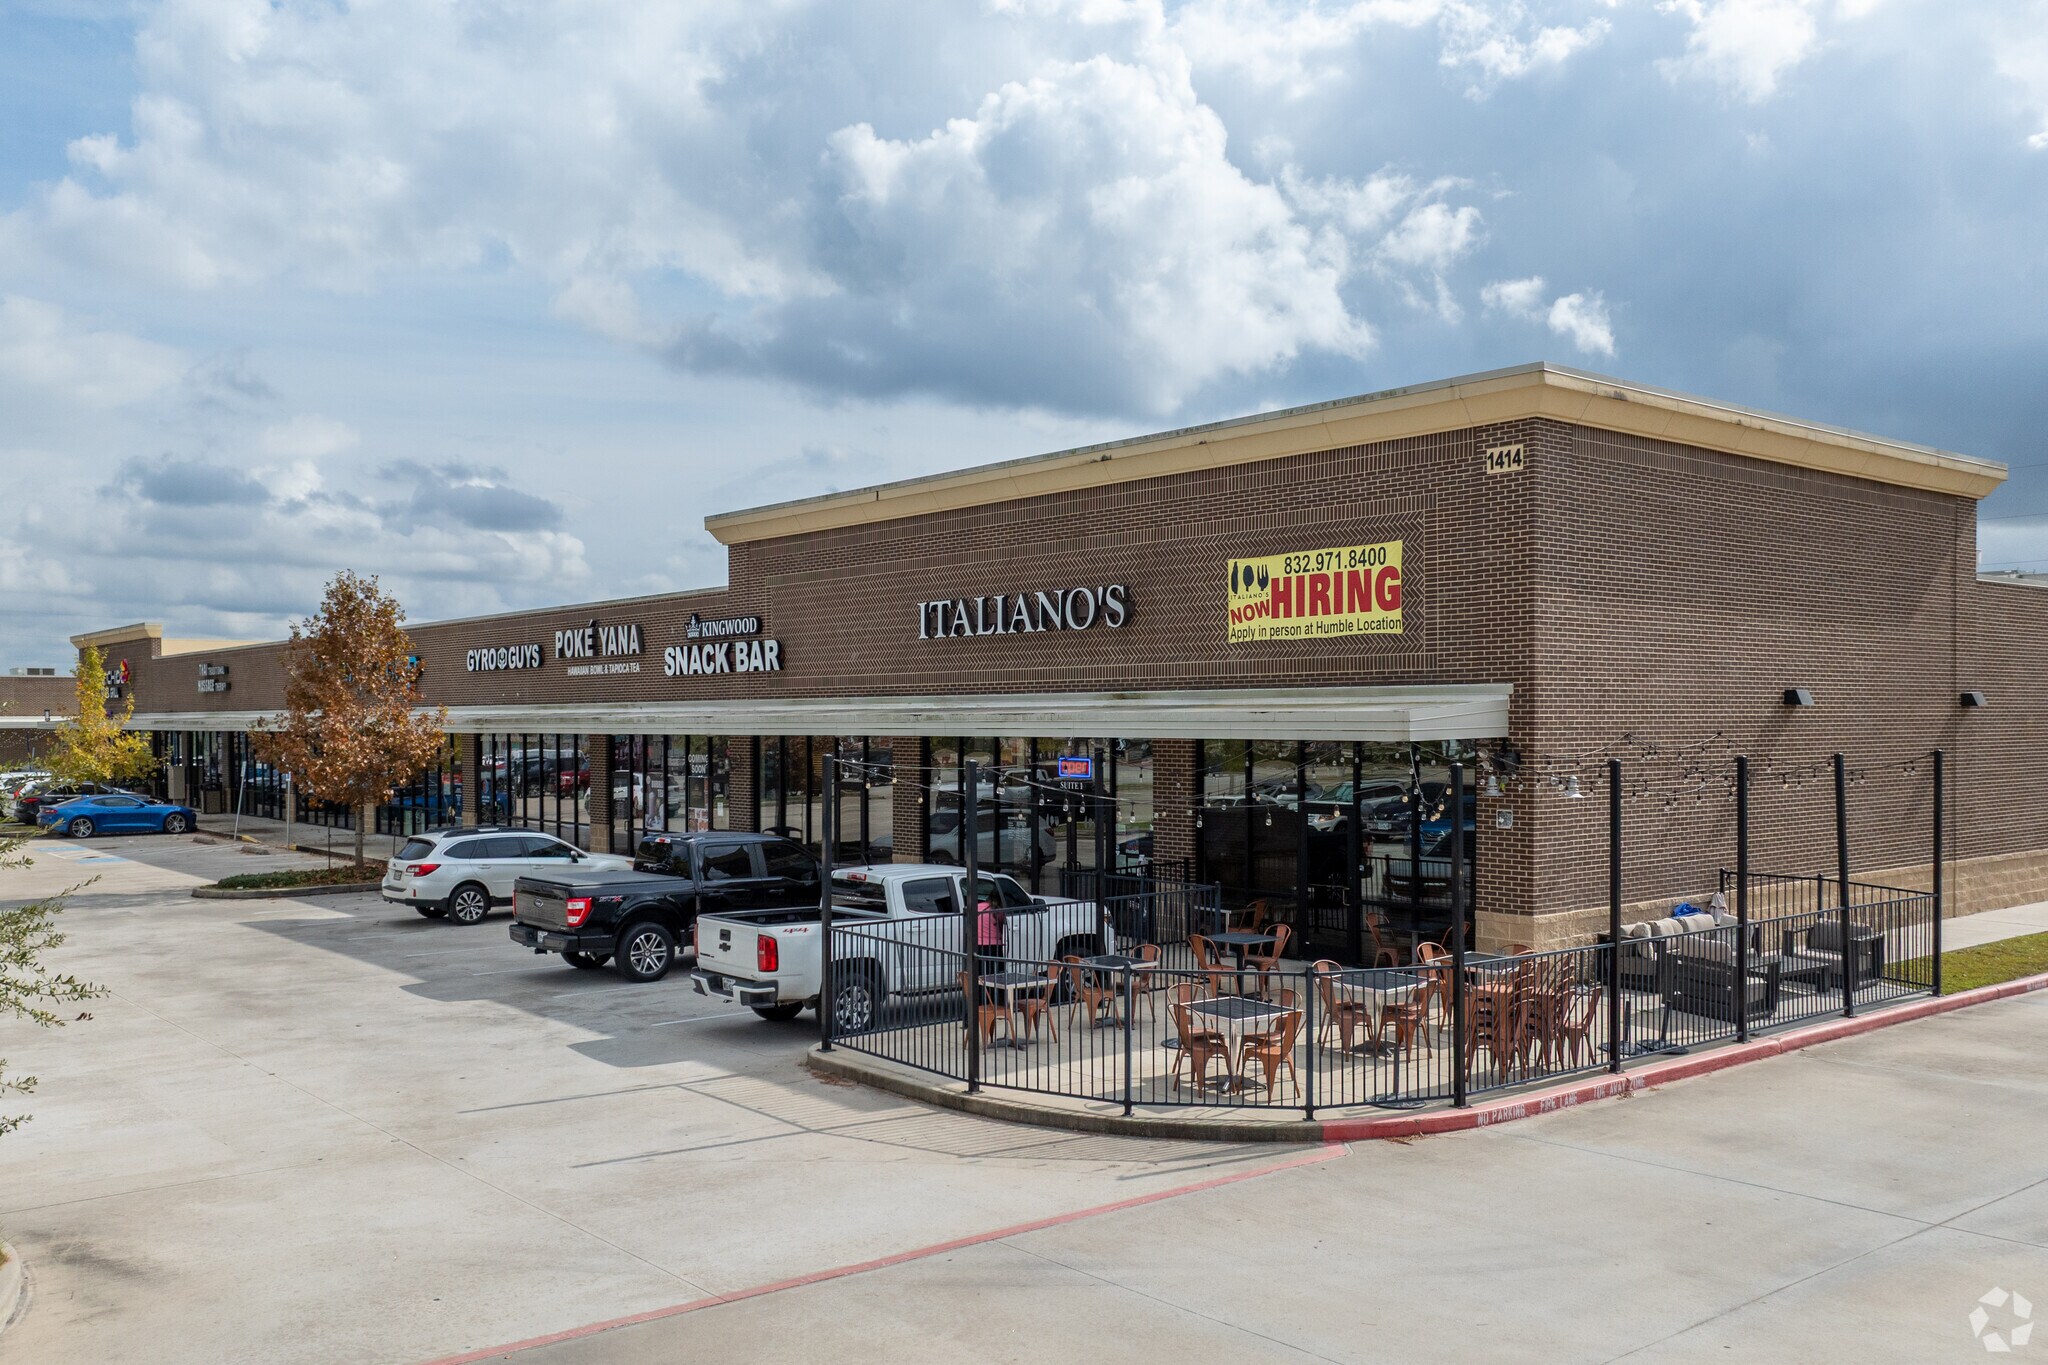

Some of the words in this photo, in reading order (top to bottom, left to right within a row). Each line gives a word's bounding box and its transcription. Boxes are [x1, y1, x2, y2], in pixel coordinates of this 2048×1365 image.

[1487, 447, 1522, 470] 1414
[1284, 546, 1387, 575] 832.971.8400
[1230, 592, 1270, 601] ITALIANO'S
[1270, 565, 1402, 619] HIRING
[917, 584, 1125, 640] ITALIANO'S
[1230, 599, 1270, 625] NOW
[555, 619, 594, 658] POKÉ
[599, 624, 640, 656] YANA
[702, 617, 757, 637] KINGWOOD
[1230, 625, 1256, 642] Apply
[1258, 625, 1267, 637] in
[1269, 625, 1302, 639] person
[1304, 622, 1314, 635] at
[1316, 618, 1354, 634] Humble
[1356, 616, 1402, 632] Location
[467, 647, 495, 671] GYRO
[508, 644, 540, 669] GUYS
[630, 662, 641, 673] TEA
[664, 642, 730, 676] SNACK
[735, 639, 780, 672] BAR
[688, 753, 708, 763] COMING
[691, 764, 706, 774] SOON
[1060, 781, 1079, 790] SUITE
[1477, 1112, 1489, 1126] NO
[1491, 1104, 1526, 1123] PARKING
